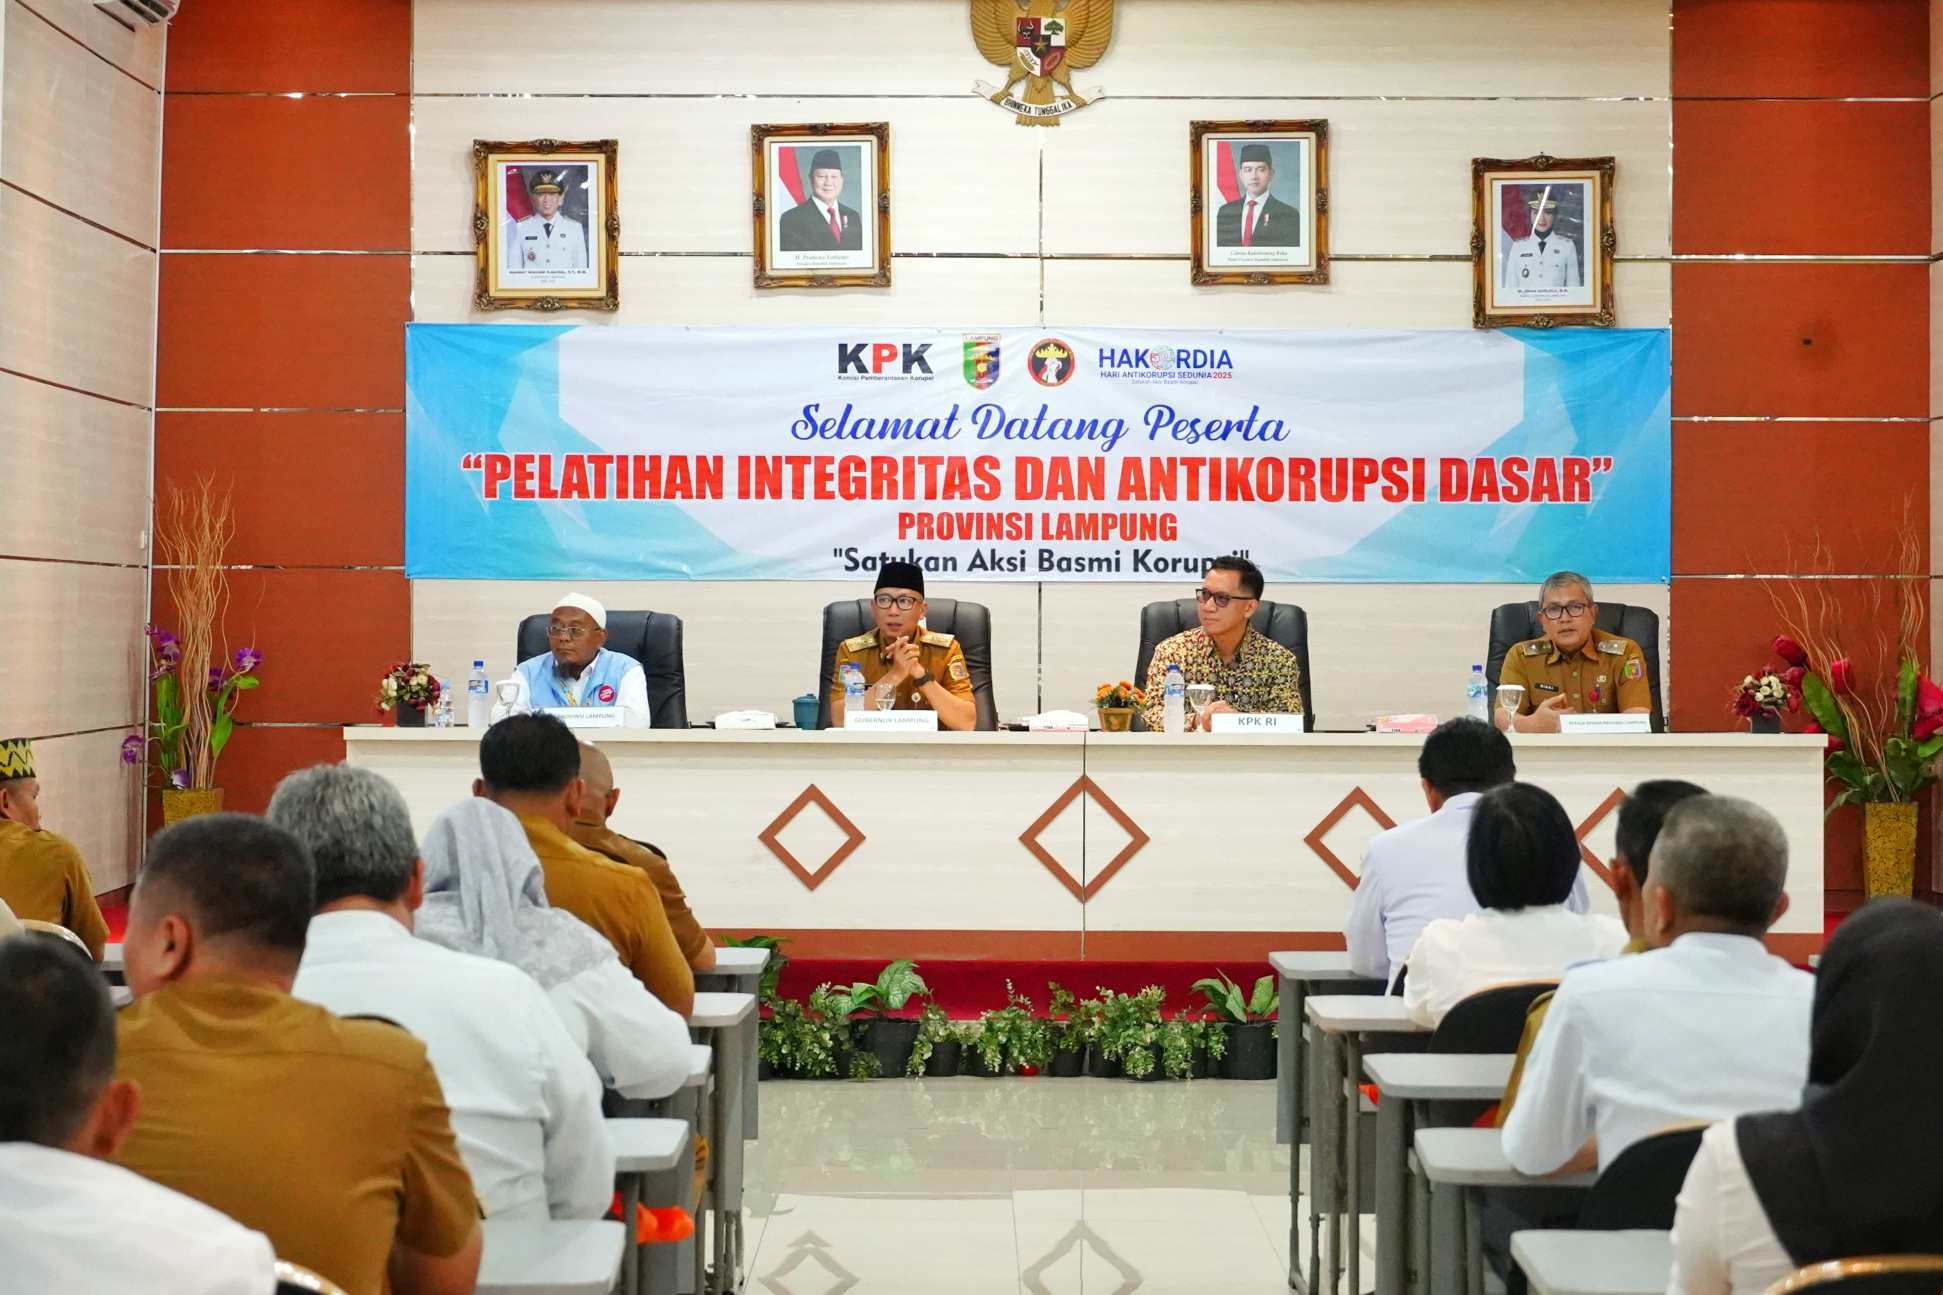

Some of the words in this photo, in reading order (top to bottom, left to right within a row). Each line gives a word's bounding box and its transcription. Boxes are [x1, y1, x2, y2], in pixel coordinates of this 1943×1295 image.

[838, 343, 933, 374] KPK
[1122, 371, 1176, 379] ANTIKORUPSI
[1178, 371, 1213, 379] SEDUNIA
[1213, 371, 1233, 379] 2025
[791, 402, 961, 441] Selamat
[971, 403, 1129, 452] Datang
[1143, 404, 1291, 444] Peserta
[738, 455, 1001, 501] INTEGRITAS
[1015, 456, 1105, 501] DAN
[1117, 456, 1426, 503] ANTIKORUPSI
[899, 512, 1033, 541] PROVINSI
[1042, 513, 1178, 541] LAMPUNG
[967, 548, 1026, 572] Aksi
[1038, 549, 1121, 573] Basmi
[1238, 717, 1261, 726] KPK
[1265, 717, 1277, 726] RI
